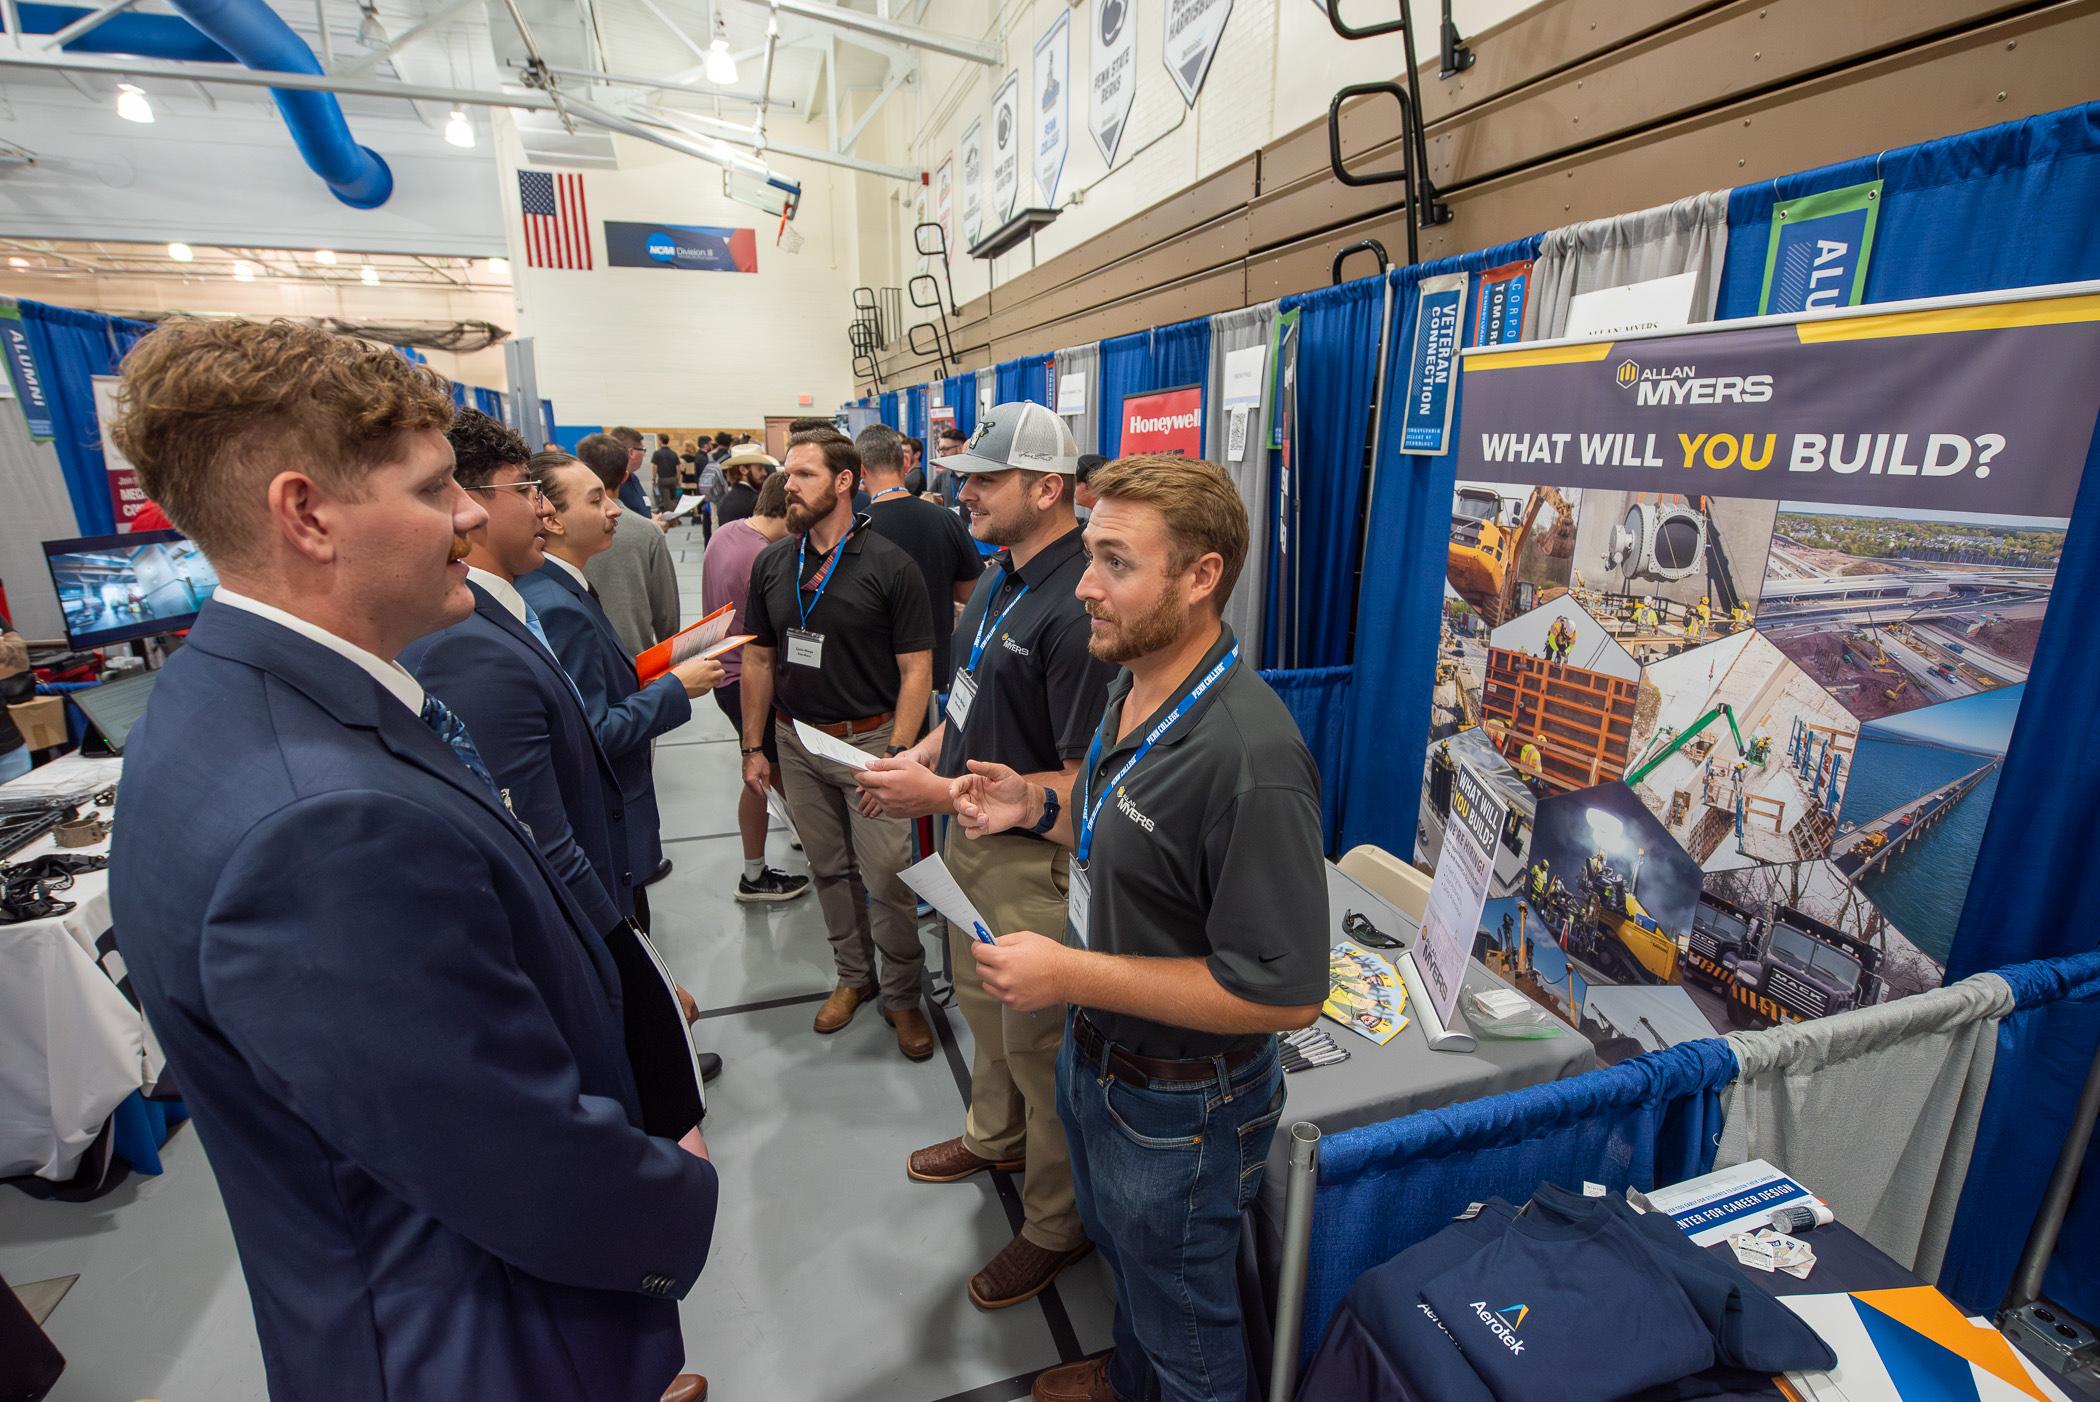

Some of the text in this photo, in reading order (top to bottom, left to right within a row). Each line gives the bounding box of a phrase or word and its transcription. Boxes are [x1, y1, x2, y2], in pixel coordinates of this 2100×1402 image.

[650, 245, 675, 255] NCAA
[676, 247, 706, 256] Division
[1419, 306, 1441, 416] CONNECTION
[1435, 303, 1456, 384] VETERAN
[9, 329, 45, 406] ALUMNI
[1637, 374, 1773, 407] MYERS
[1641, 366, 1695, 380] ALLAN
[1129, 407, 1201, 435] Honeywell
[1481, 433, 2006, 479] WHAT WILL YOU BUILD?
[1003, 640, 1029, 656] MYERS
[1191, 663, 1225, 699] PENN COLLEGE
[1146, 710, 1180, 746] PENN COLLEGE
[1117, 798, 1155, 833] MYERS
[1453, 789, 1469, 818] YOU
[1468, 809, 1495, 850] BUILD?
[1459, 770, 1499, 830] WHAT WILL
[1448, 816, 1465, 847] WE'RE
[1463, 838, 1486, 876] HIRING!
[1423, 943, 1448, 1002] MYERS
[1774, 972, 1823, 1002] MACK
[1676, 1183, 1796, 1230] NTER FOR CAREER DESIGN
[1469, 1301, 1525, 1356] Aerotek
